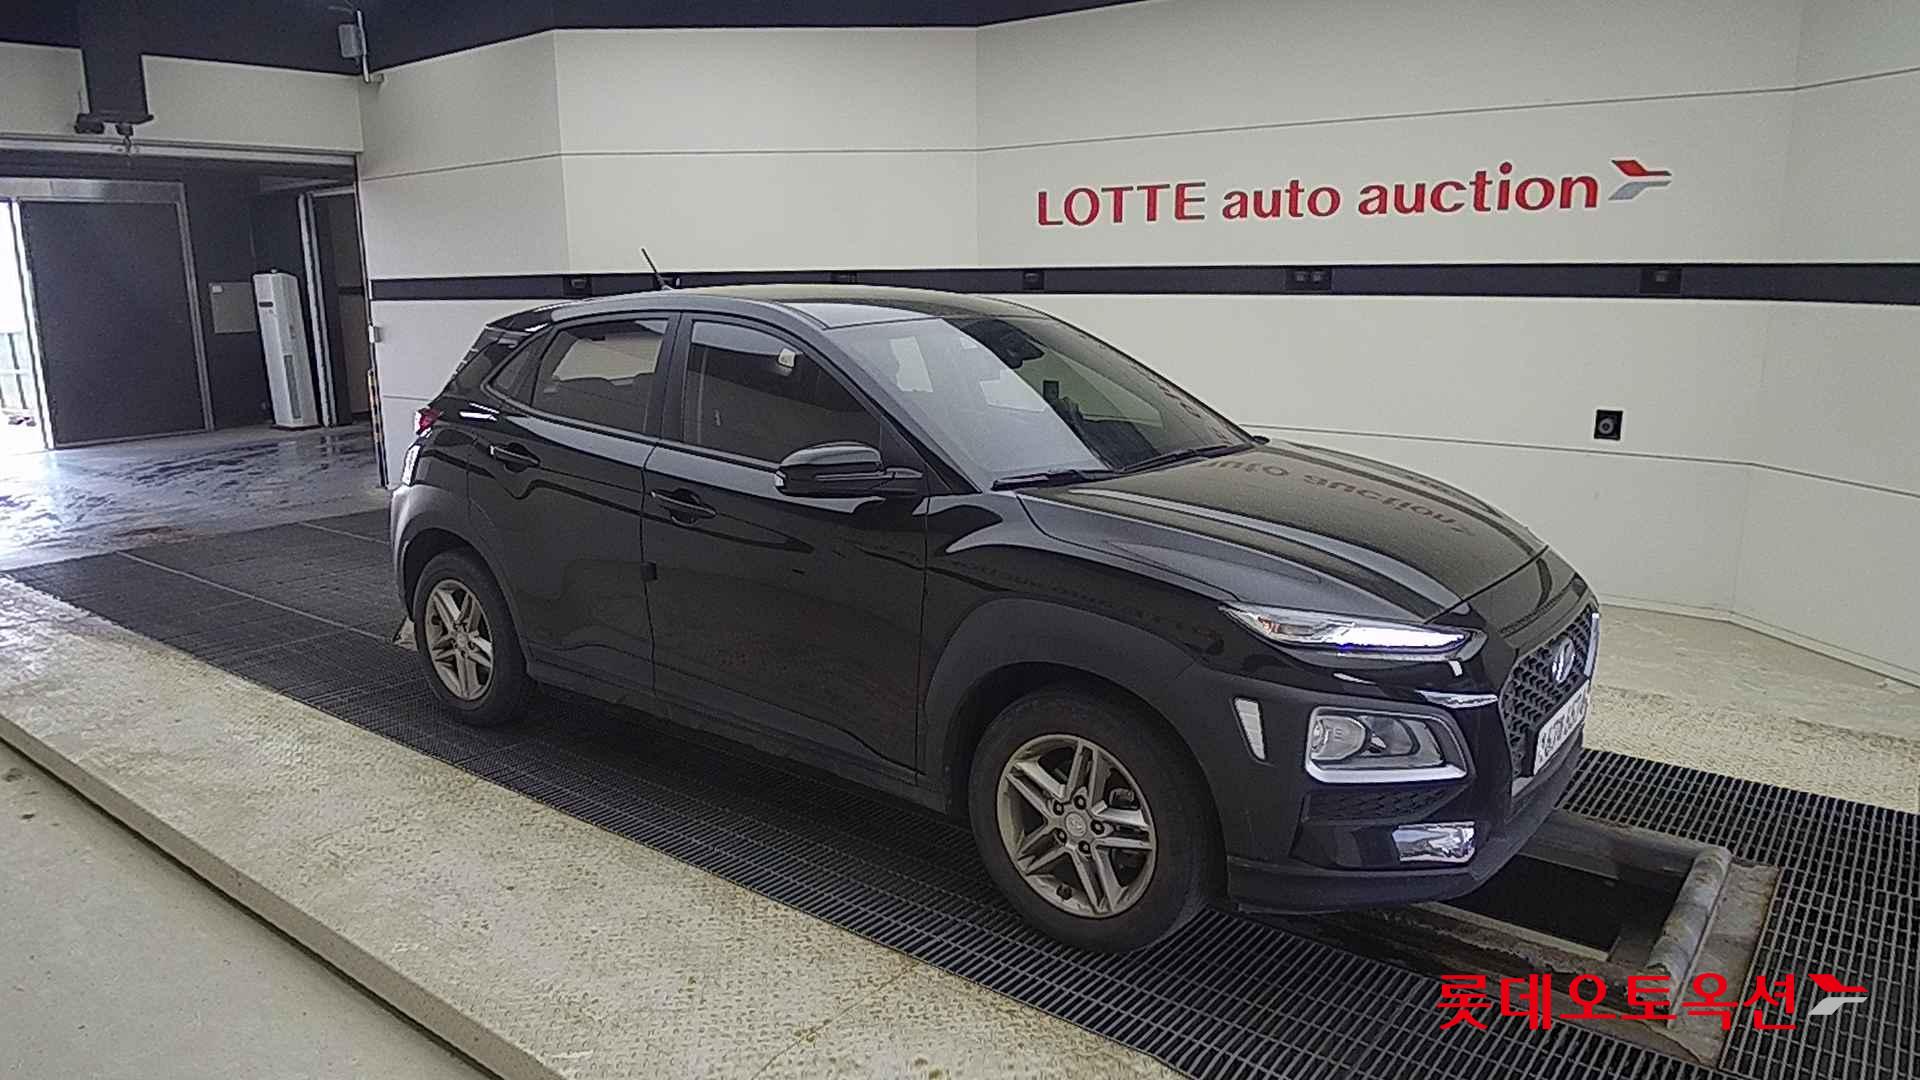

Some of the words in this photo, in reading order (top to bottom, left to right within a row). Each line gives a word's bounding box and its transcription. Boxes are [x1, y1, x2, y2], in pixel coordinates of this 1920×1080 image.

[1037, 182, 1206, 226] LOTTE
[1222, 180, 1341, 219] auto
[1357, 162, 1599, 214] auction
